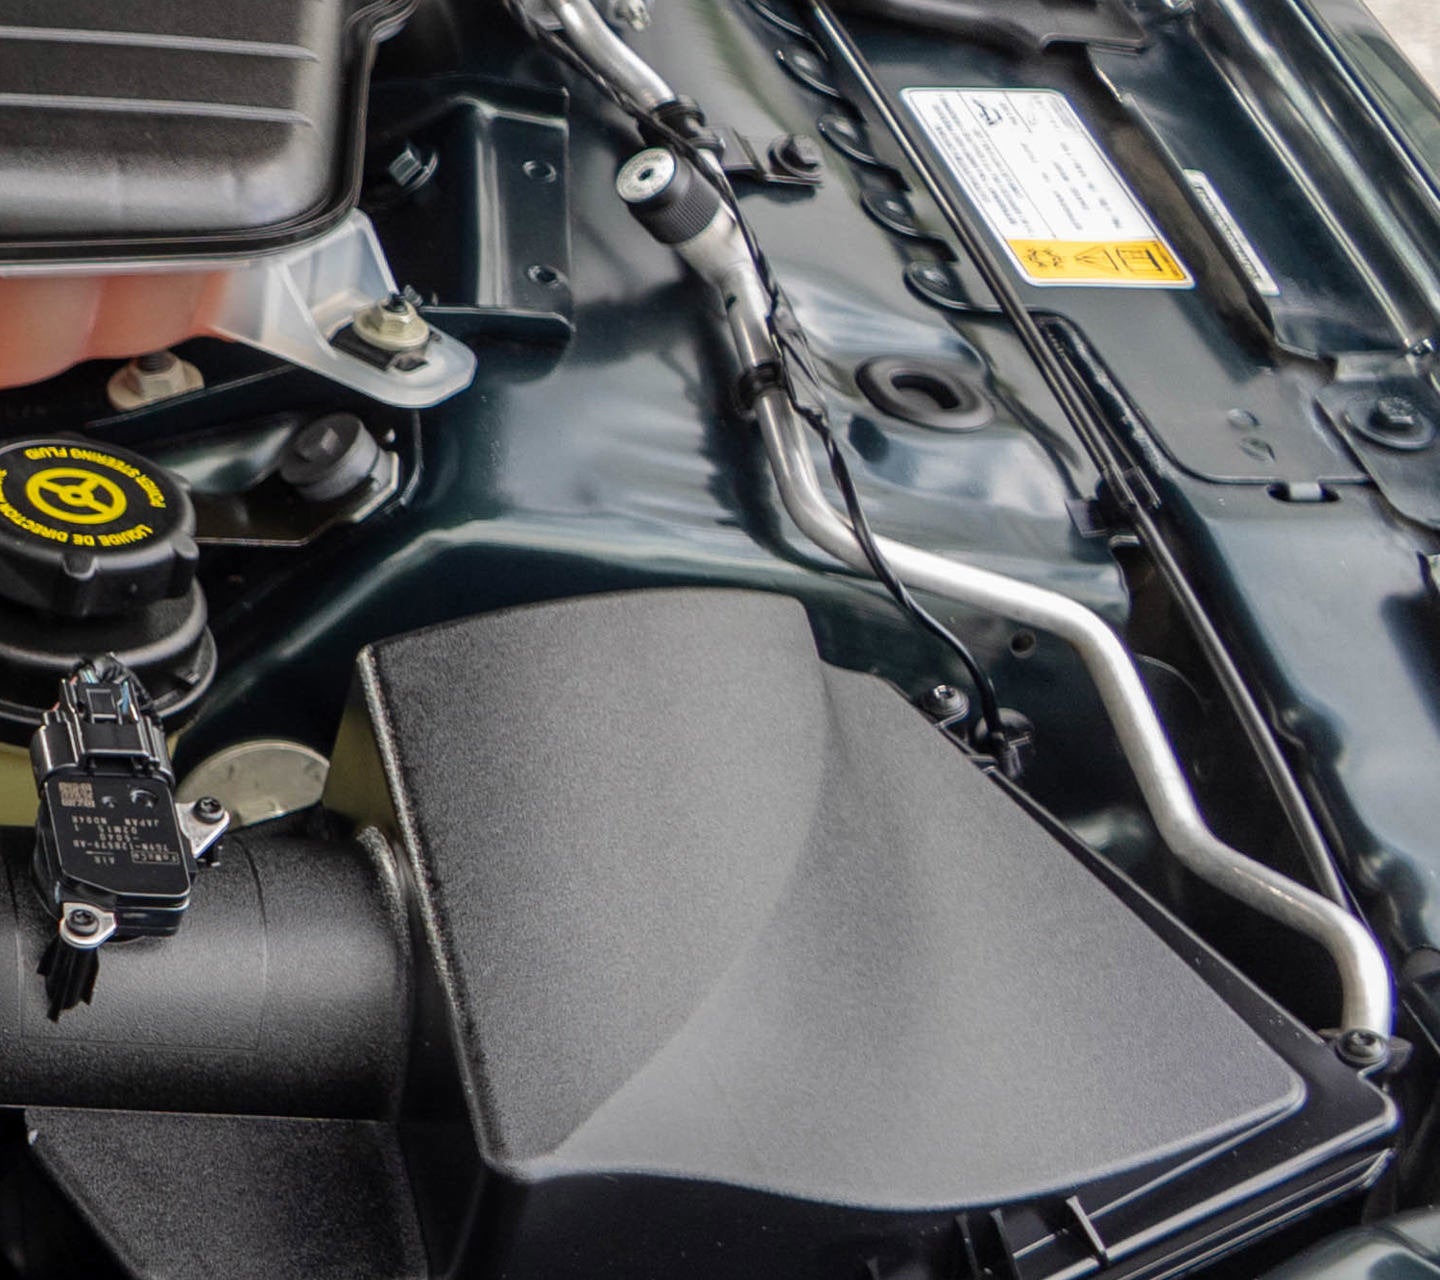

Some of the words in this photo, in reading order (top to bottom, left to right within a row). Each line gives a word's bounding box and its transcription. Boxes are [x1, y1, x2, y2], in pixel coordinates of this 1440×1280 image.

[24, 447, 68, 460] FLUID
[70, 448, 140, 479] STEERING
[73, 534, 95, 546] DE
[98, 524, 153, 547] LIQUIDE
[124, 818, 159, 827] JAPAN
